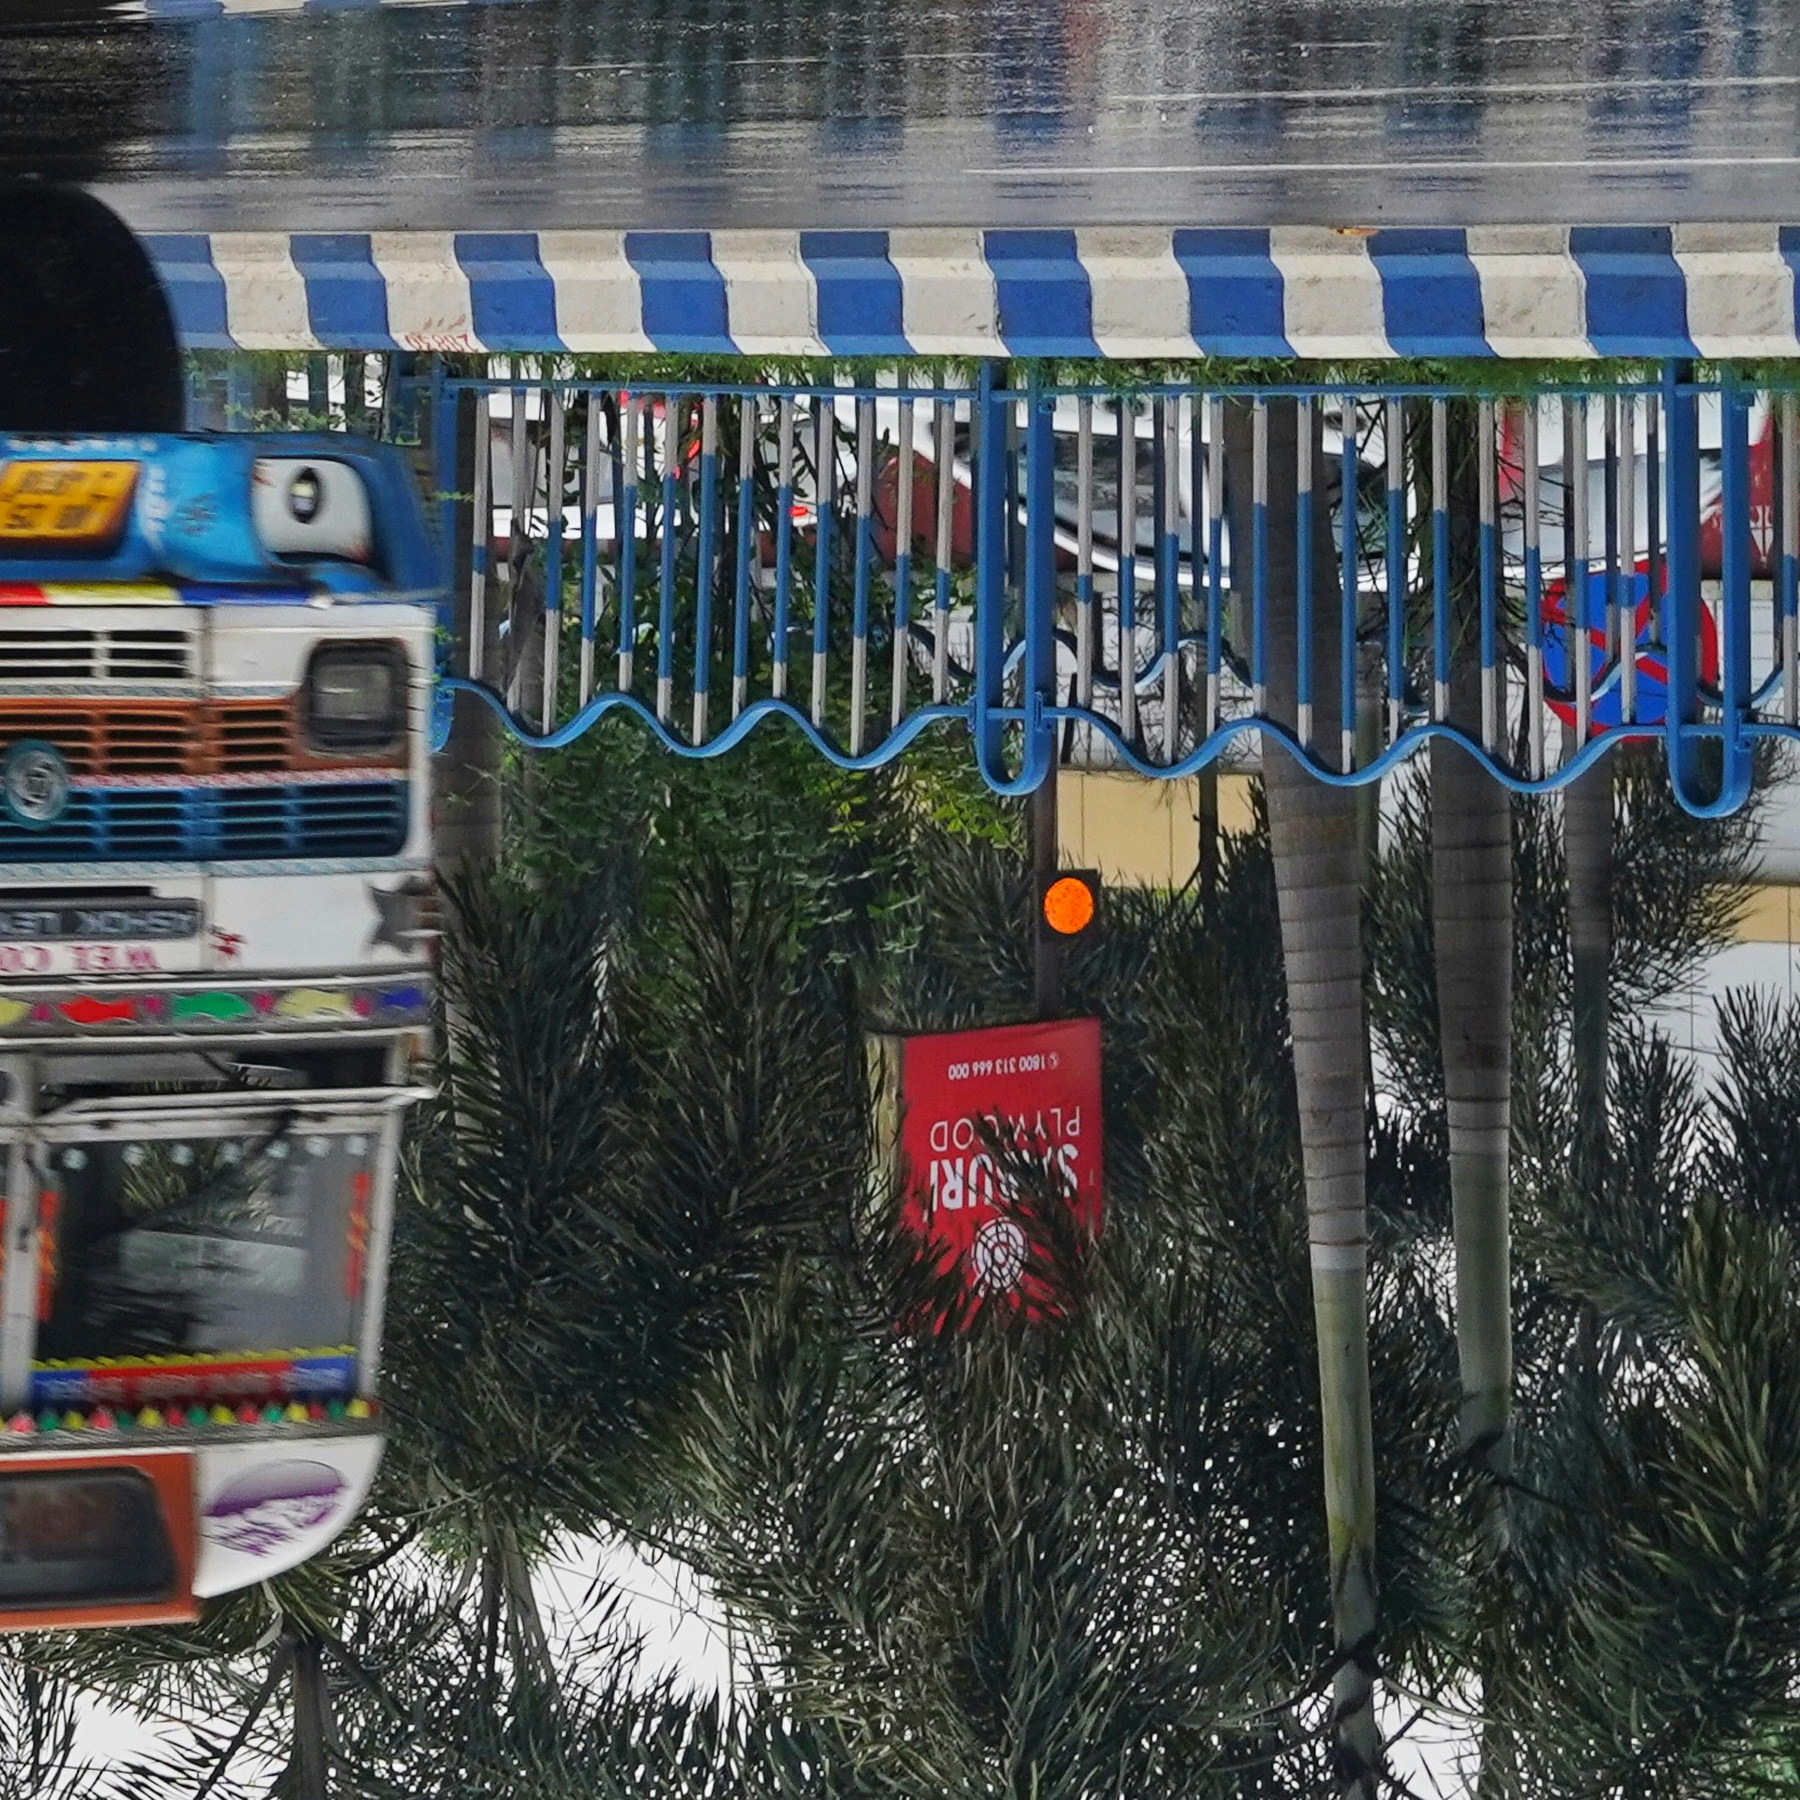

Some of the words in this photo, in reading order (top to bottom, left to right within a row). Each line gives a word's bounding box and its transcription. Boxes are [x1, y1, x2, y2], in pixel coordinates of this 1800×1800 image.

[948, 1062, 969, 1079] 000
[995, 1058, 1016, 1074] 313
[1019, 1055, 1046, 1071] 1800
